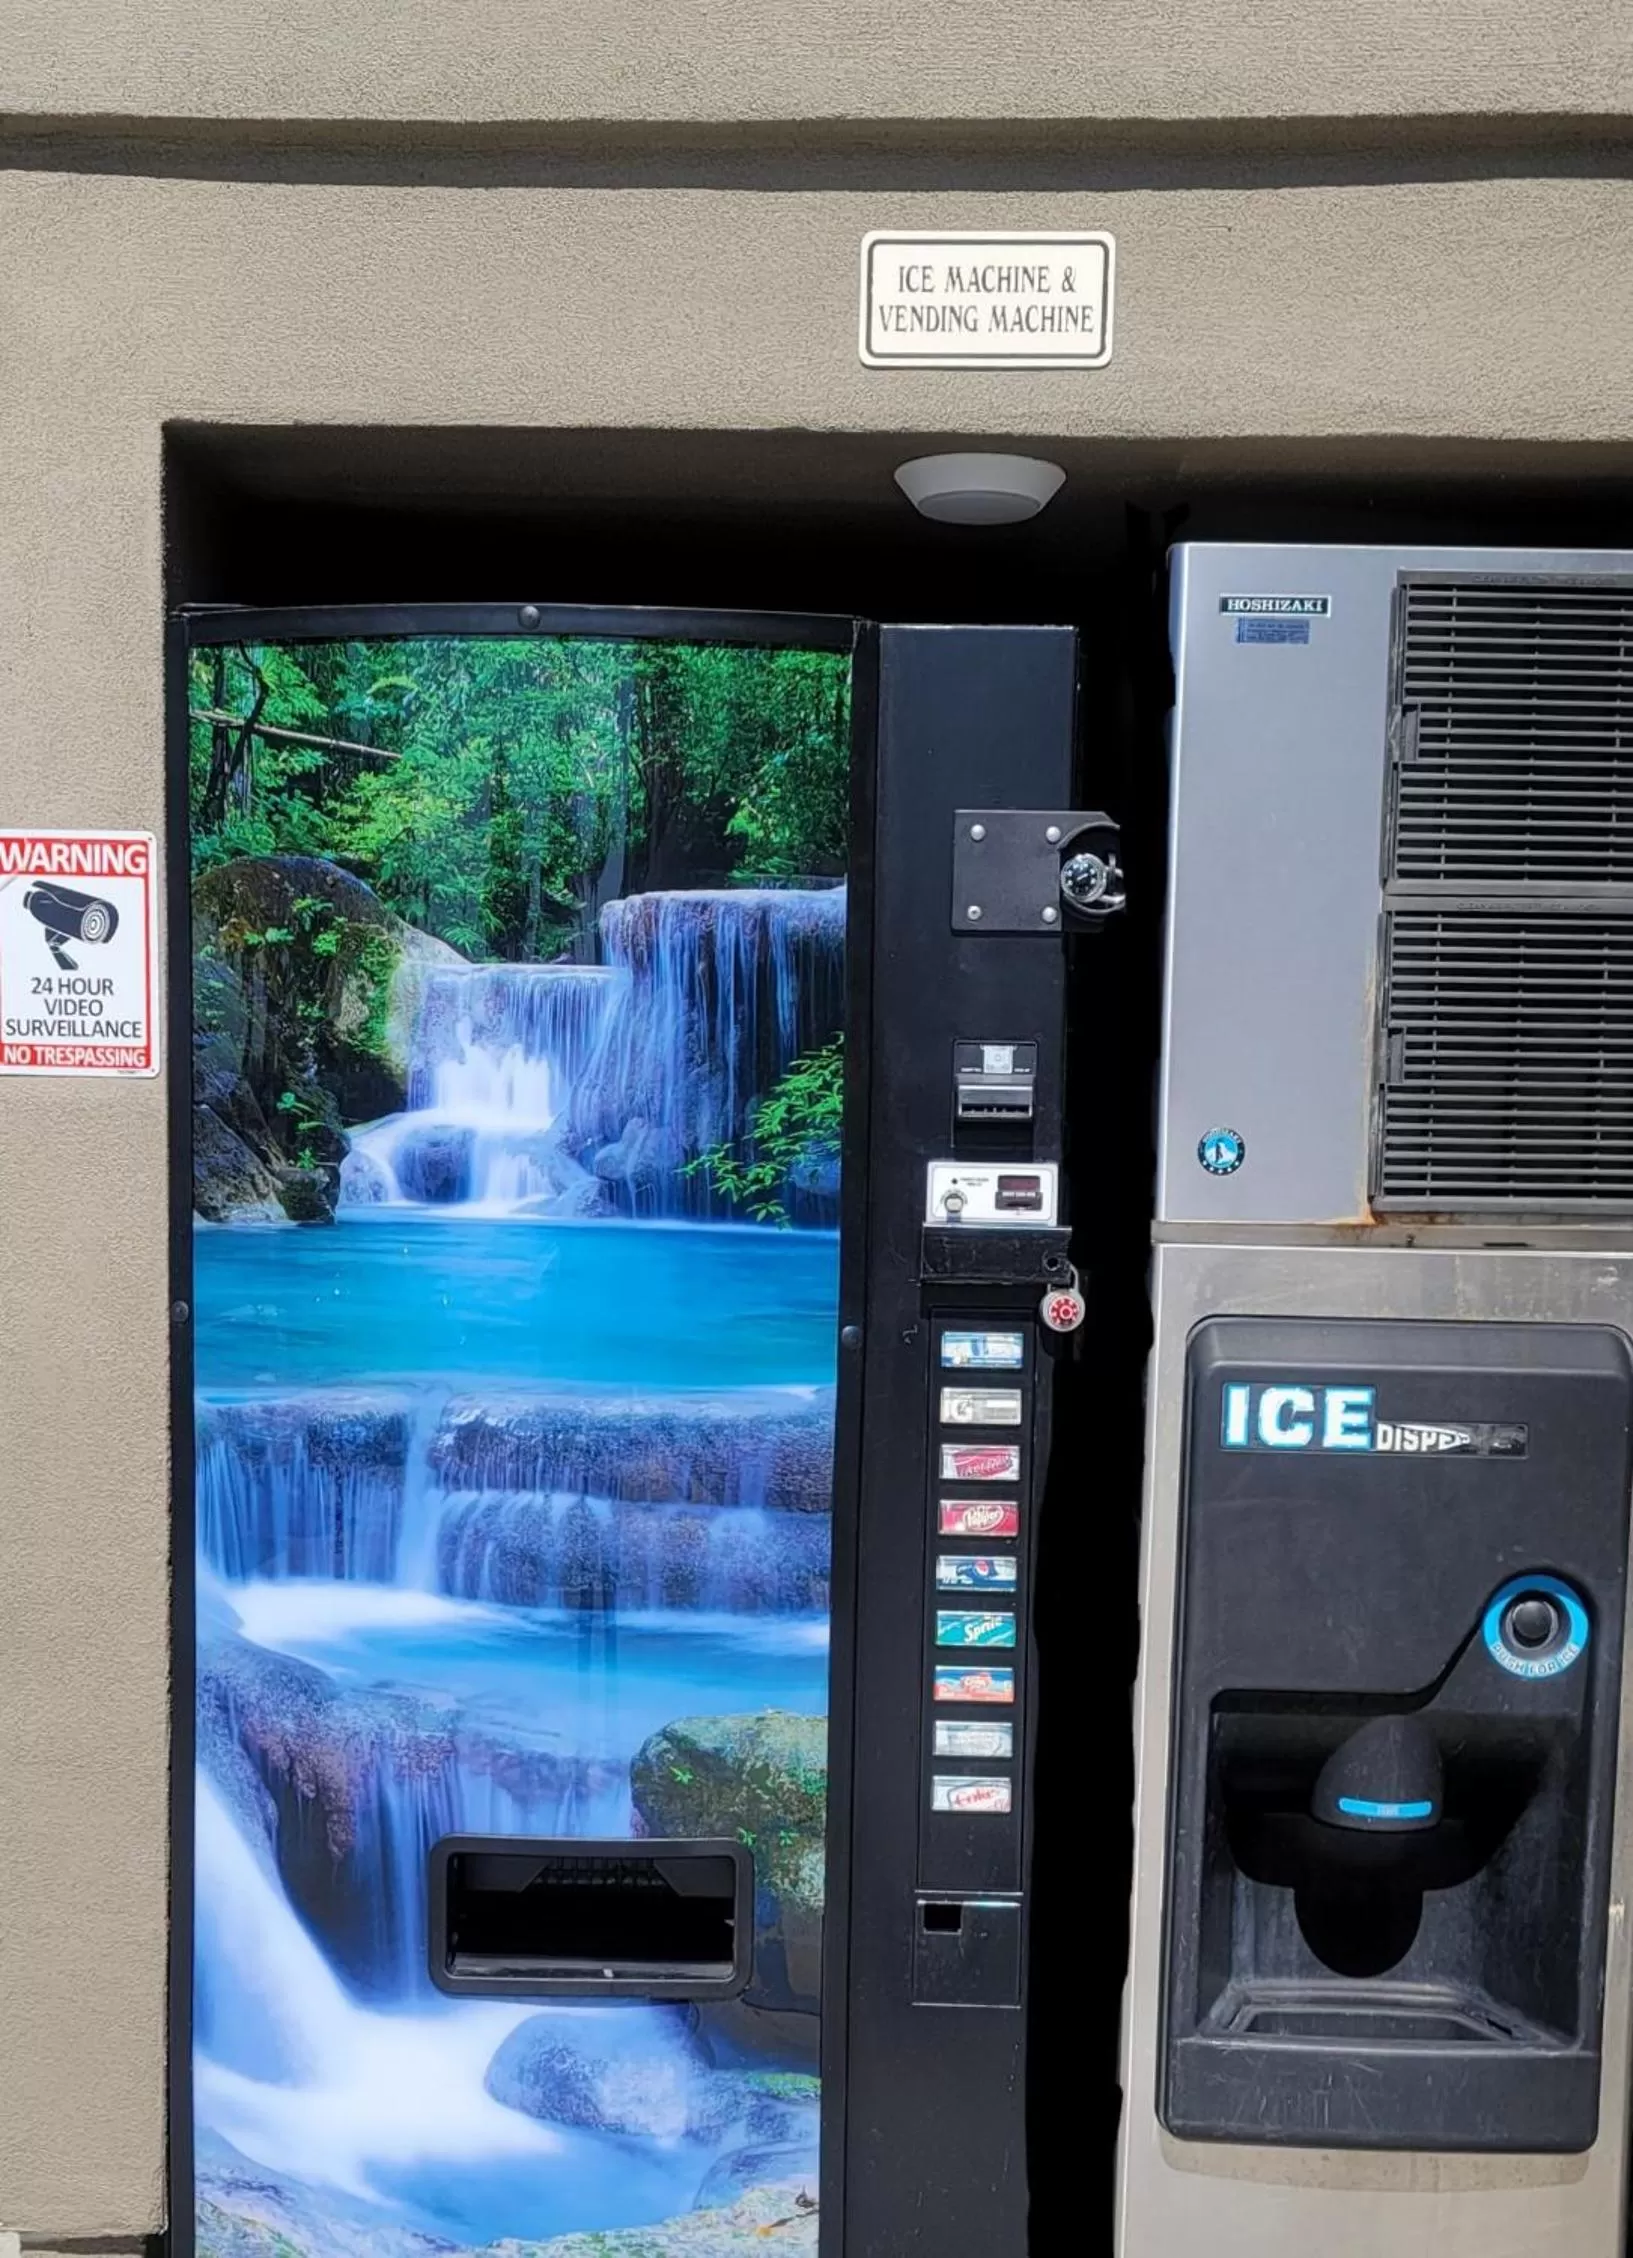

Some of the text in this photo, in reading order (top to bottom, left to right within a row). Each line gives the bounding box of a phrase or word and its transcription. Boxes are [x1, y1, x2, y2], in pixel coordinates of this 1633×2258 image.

[898, 265, 1077, 293] ICE MACHINE &
[879, 304, 1094, 333] VENDING MACHINE
[1227, 598, 1323, 612] HOSHIZAKI
[0, 841, 147, 874] WARNING
[30, 977, 114, 996] 24 HOUR
[44, 998, 104, 1017] VIDEO
[5, 1018, 142, 1038] SURVEILLANCE
[4, 1045, 146, 1068] NO TRESPASSING
[1225, 1386, 1373, 1448] ICE
[1558, 1642, 1580, 1667] ICE
